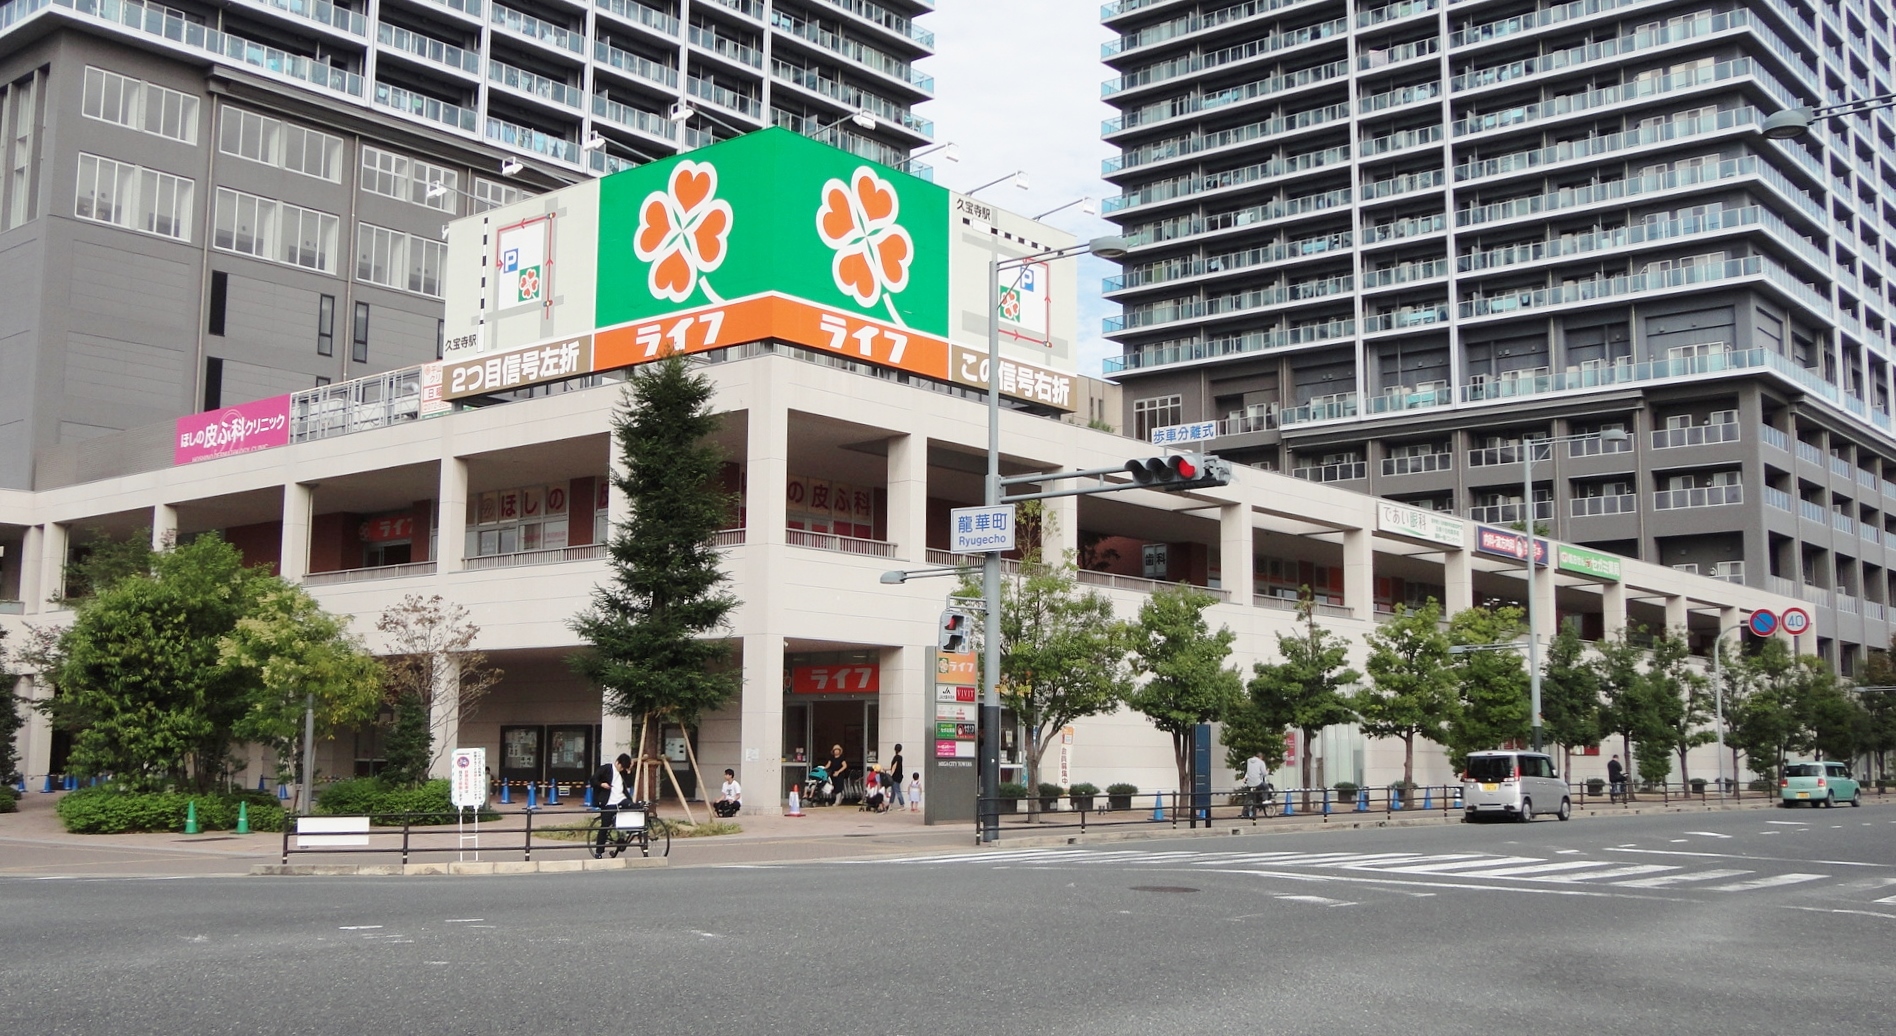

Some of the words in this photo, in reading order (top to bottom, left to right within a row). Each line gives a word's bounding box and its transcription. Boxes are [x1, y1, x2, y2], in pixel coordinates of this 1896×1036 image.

[957, 198, 991, 221] 久宝寺駅
[445, 334, 477, 352] 久宝寺駅
[636, 310, 725, 357] ライフ
[820, 314, 908, 364] ライフ
[451, 341, 580, 393] 2つ目信号左折
[180, 414, 285, 448] ほしの皮ふ科クリニック
[1153, 423, 1214, 445] 歩車分離式
[958, 513, 1007, 533] 龍華町
[1383, 506, 1427, 531] であい眼科
[959, 534, 1006, 547] Ryugecho
[1787, 614, 1804, 627] 40
[949, 661, 974, 672] ライフ
[811, 667, 872, 689] ライフ
[957, 689, 975, 697] VIVIT
